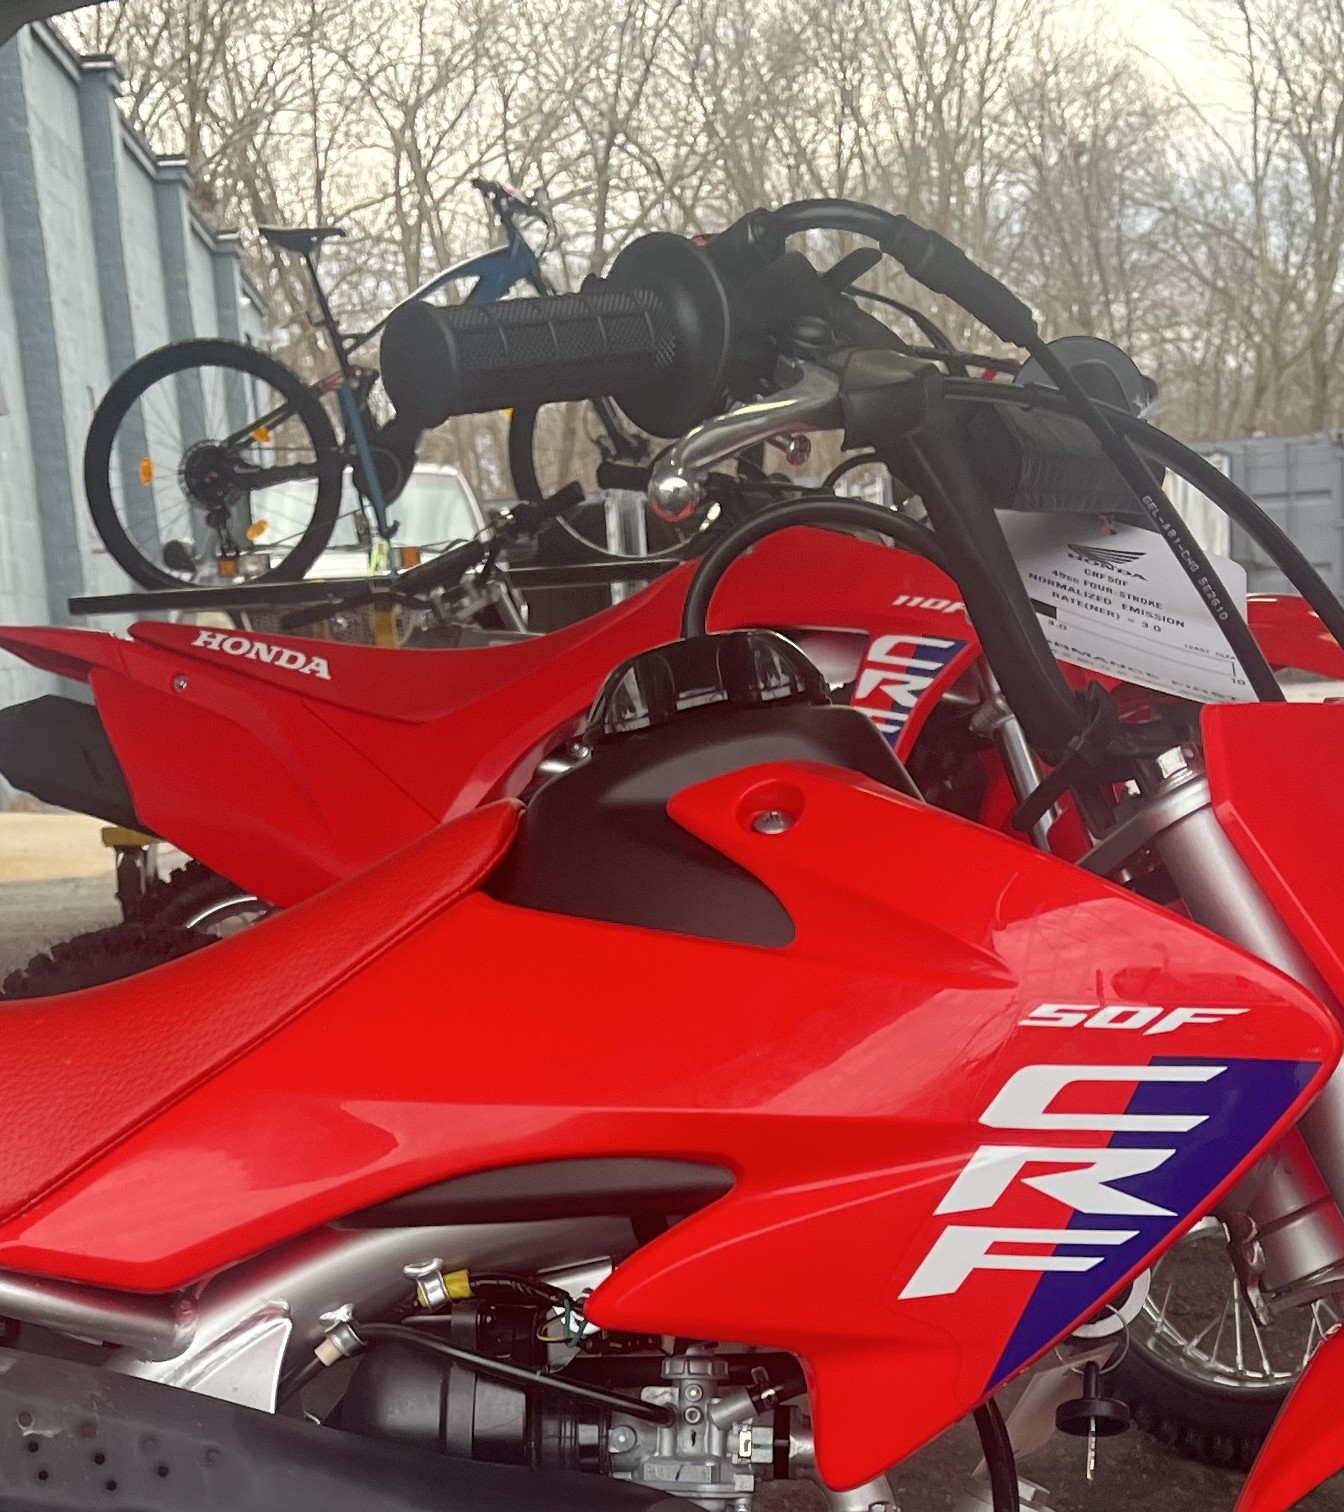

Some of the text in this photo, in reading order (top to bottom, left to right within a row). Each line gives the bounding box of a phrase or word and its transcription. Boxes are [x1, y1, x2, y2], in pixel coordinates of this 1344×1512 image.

[1067, 551, 1149, 582] HONDA
[1028, 572, 1185, 629] NORMALIZED EMISSION
[190, 630, 332, 680] HONDA
[1018, 1003, 1252, 1036] 50F
[897, 1064, 1229, 1301] CRF
